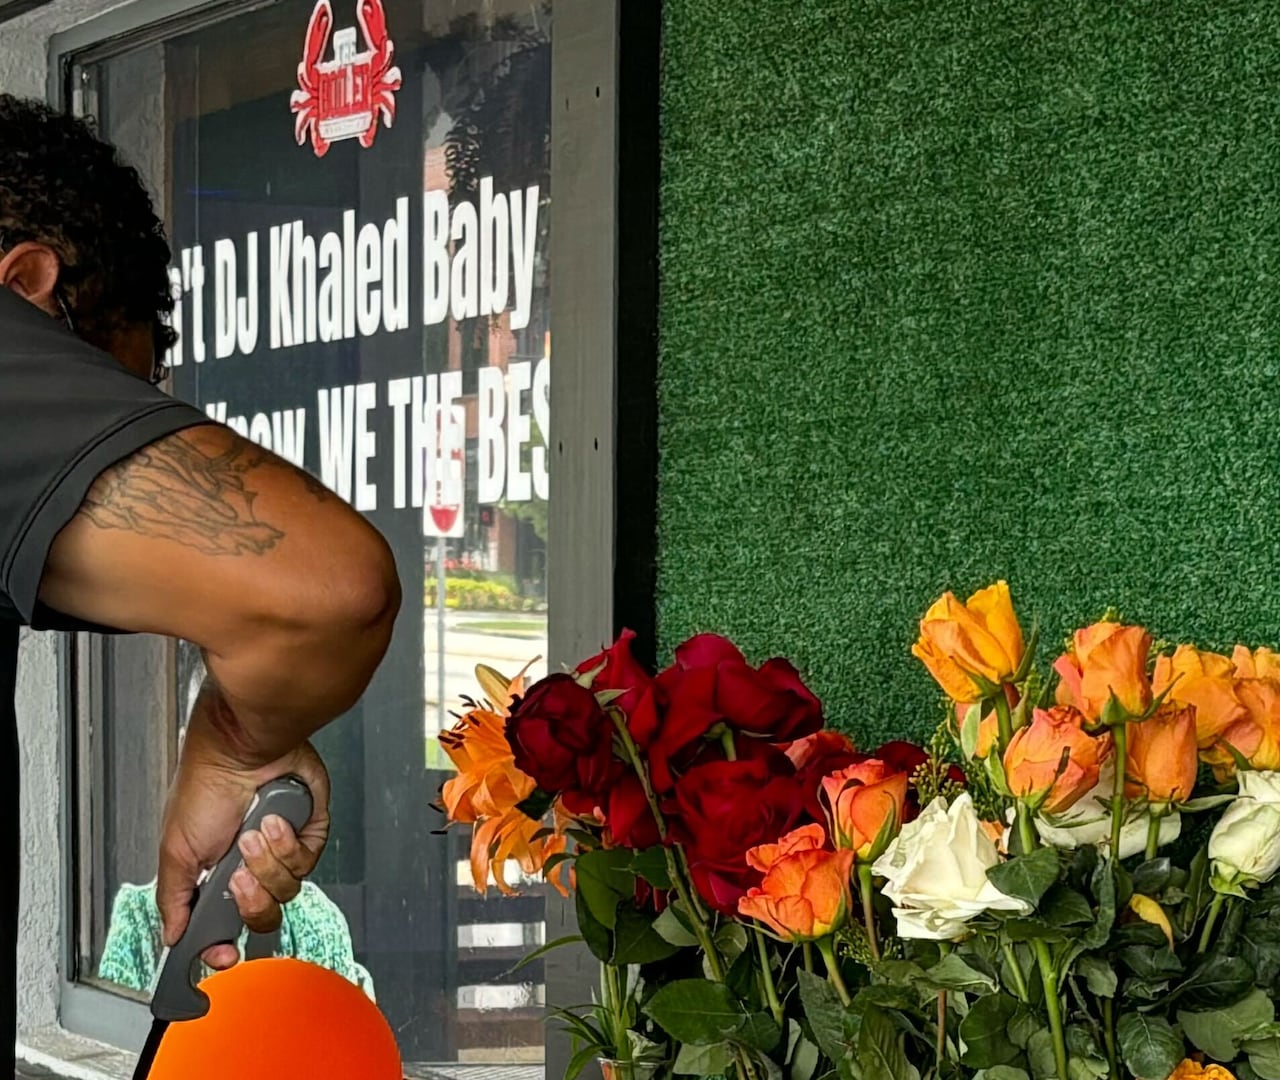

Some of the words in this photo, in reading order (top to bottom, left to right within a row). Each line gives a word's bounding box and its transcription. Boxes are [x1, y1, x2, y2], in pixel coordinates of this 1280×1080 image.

[163, 245, 206, 368] n't
[214, 231, 259, 360] DJ
[269, 195, 410, 350] Khaled
[423, 175, 540, 332] Baby
[317, 382, 377, 512] WE
[388, 371, 463, 509] THE
[478, 358, 551, 503] BES
